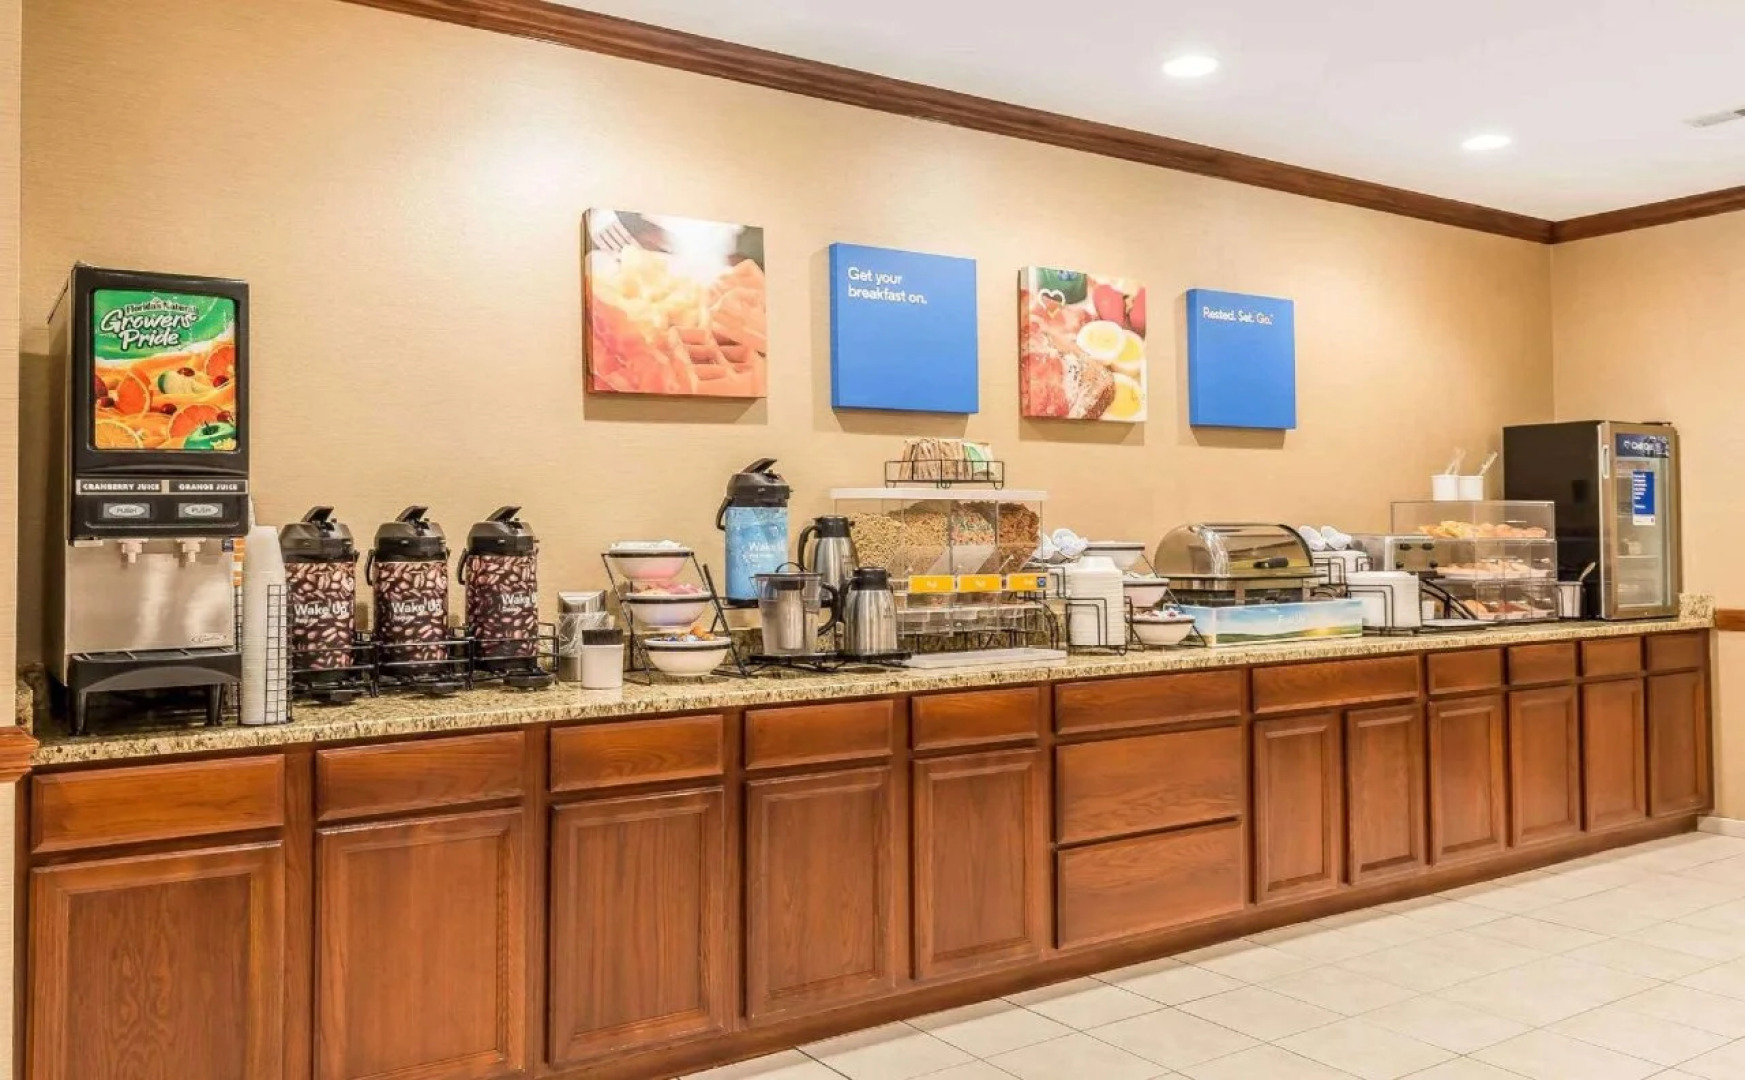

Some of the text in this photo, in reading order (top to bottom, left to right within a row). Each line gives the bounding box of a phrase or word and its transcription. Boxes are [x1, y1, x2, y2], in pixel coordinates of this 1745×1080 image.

[847, 266, 904, 286] Get your
[847, 284, 928, 305] breakfast on.
[1203, 306, 1237, 321] Rested.
[1237, 309, 1255, 323] Set.
[119, 327, 180, 351] Pride
[82, 483, 160, 491] CRANBERRY JUICE
[178, 483, 238, 491] ORANGE JUICE
[501, 593, 531, 605] Wake
[294, 602, 347, 616] Wake Up
[391, 600, 443, 614] Wake Up
